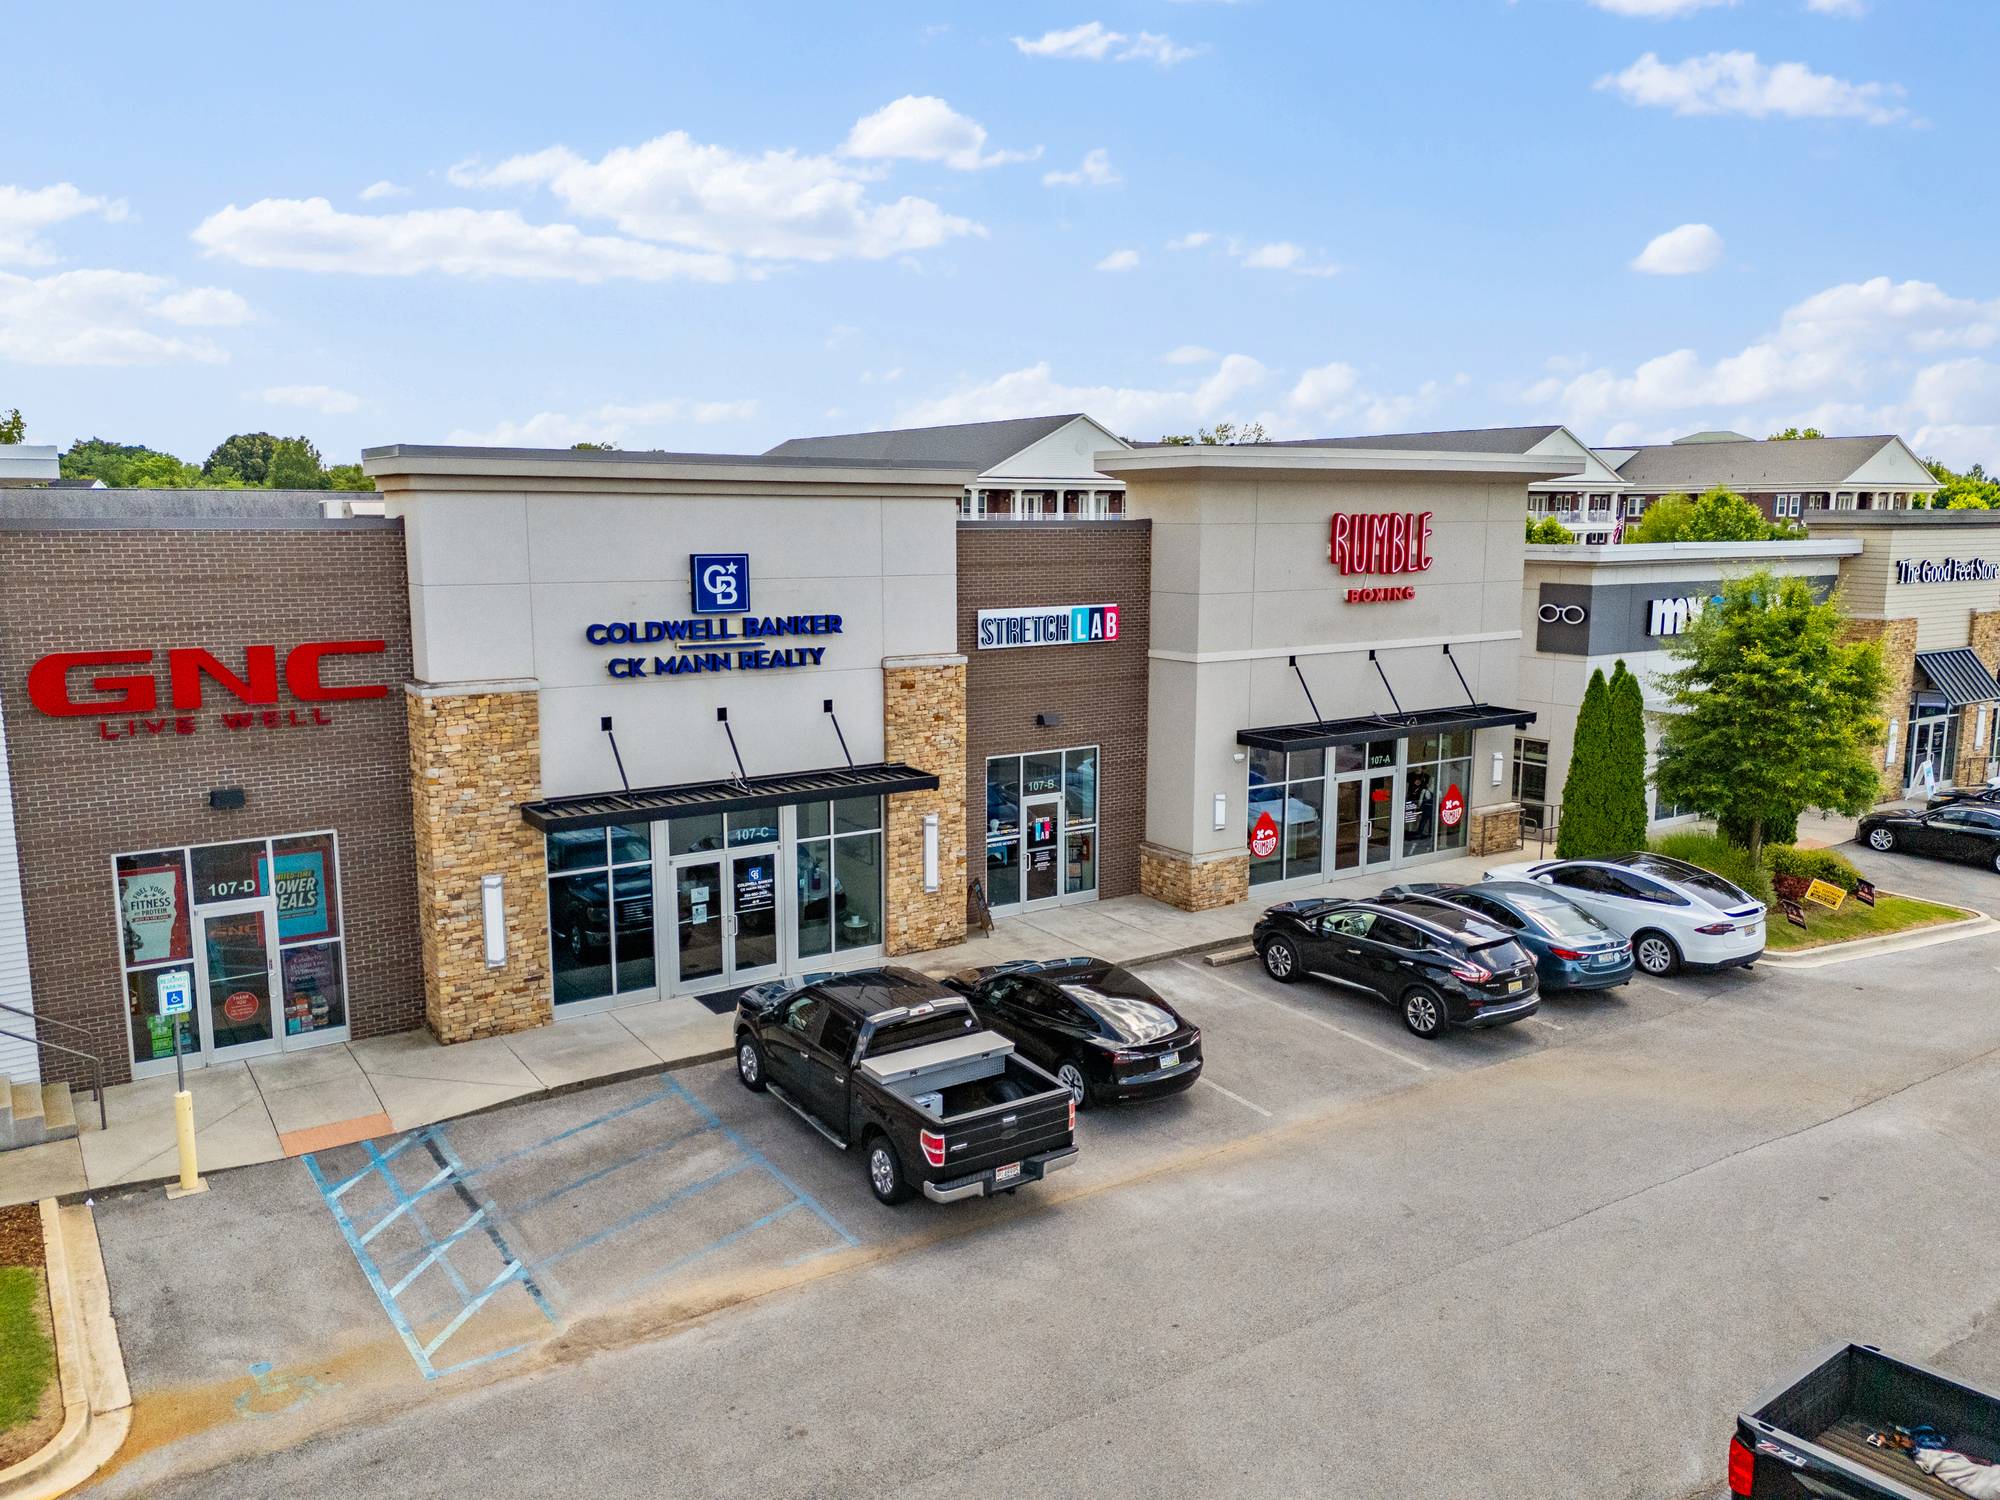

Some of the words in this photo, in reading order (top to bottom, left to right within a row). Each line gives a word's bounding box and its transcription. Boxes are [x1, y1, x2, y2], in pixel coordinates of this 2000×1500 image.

[1331, 512, 1432, 575] RUMBLE
[1896, 559, 1920, 584] The
[1920, 557, 1952, 583] Good
[1952, 559, 1976, 581] Feet
[1974, 558, 2000, 580] Store
[1347, 586, 1415, 602] BOXING
[586, 618, 737, 645] COLDWELL
[743, 615, 843, 637] BANKER
[607, 658, 647, 678] CK
[654, 652, 731, 675] MANN
[739, 647, 825, 670] REALTY
[28, 640, 388, 717] GNC
[100, 717, 197, 741] LIVE
[223, 708, 332, 730] WELL
[1371, 755, 1390, 765] 107-A
[1029, 779, 1055, 791] 107-B
[736, 827, 769, 840] 107-C
[150, 885, 167, 896] YOUR
[209, 880, 256, 896] 107-D
[275, 877, 316, 895] OWER
[131, 897, 171, 911] FITNESS
[276, 891, 316, 910] EALS
[141, 908, 167, 916] PROTEIN
